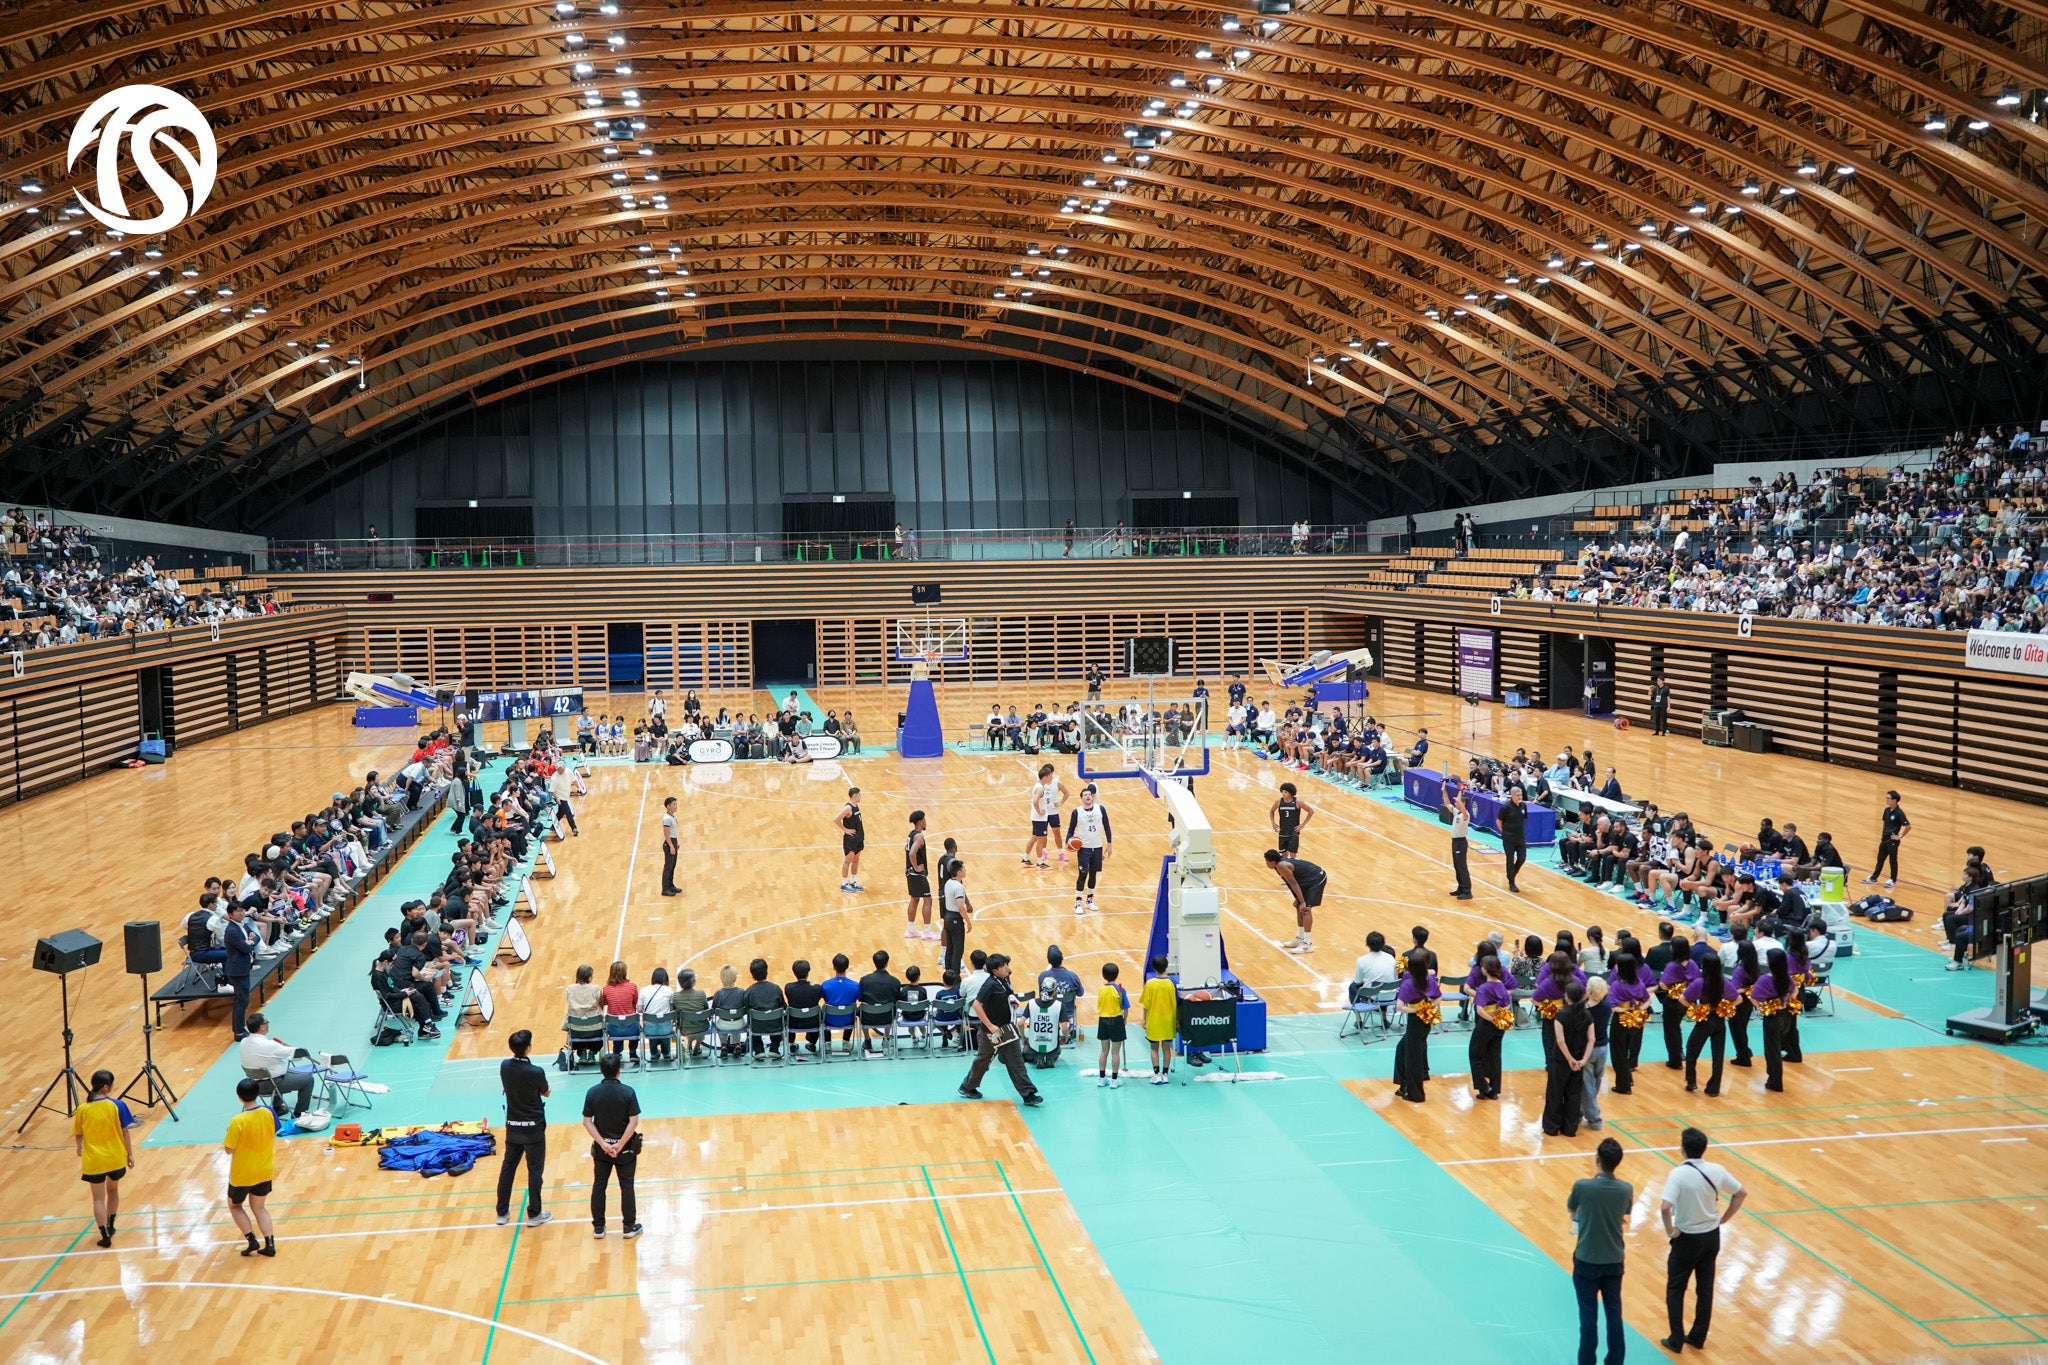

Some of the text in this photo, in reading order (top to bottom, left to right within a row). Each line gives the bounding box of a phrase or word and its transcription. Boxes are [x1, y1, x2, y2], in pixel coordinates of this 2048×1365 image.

[1493, 600, 1499, 612] D
[213, 626, 217, 639] D
[1741, 618, 1749, 634] C
[1969, 639, 2011, 659] Welcome
[2013, 644, 2022, 660] to
[2024, 643, 2044, 662] Oita
[15, 656, 22, 674] C
[554, 696, 570, 713] 42
[512, 705, 531, 718] 9:14
[1285, 810, 1290, 818] 3
[1088, 825, 1097, 833] 45
[1191, 1015, 1231, 1026] molten
[1033, 1022, 1054, 1034] 022
